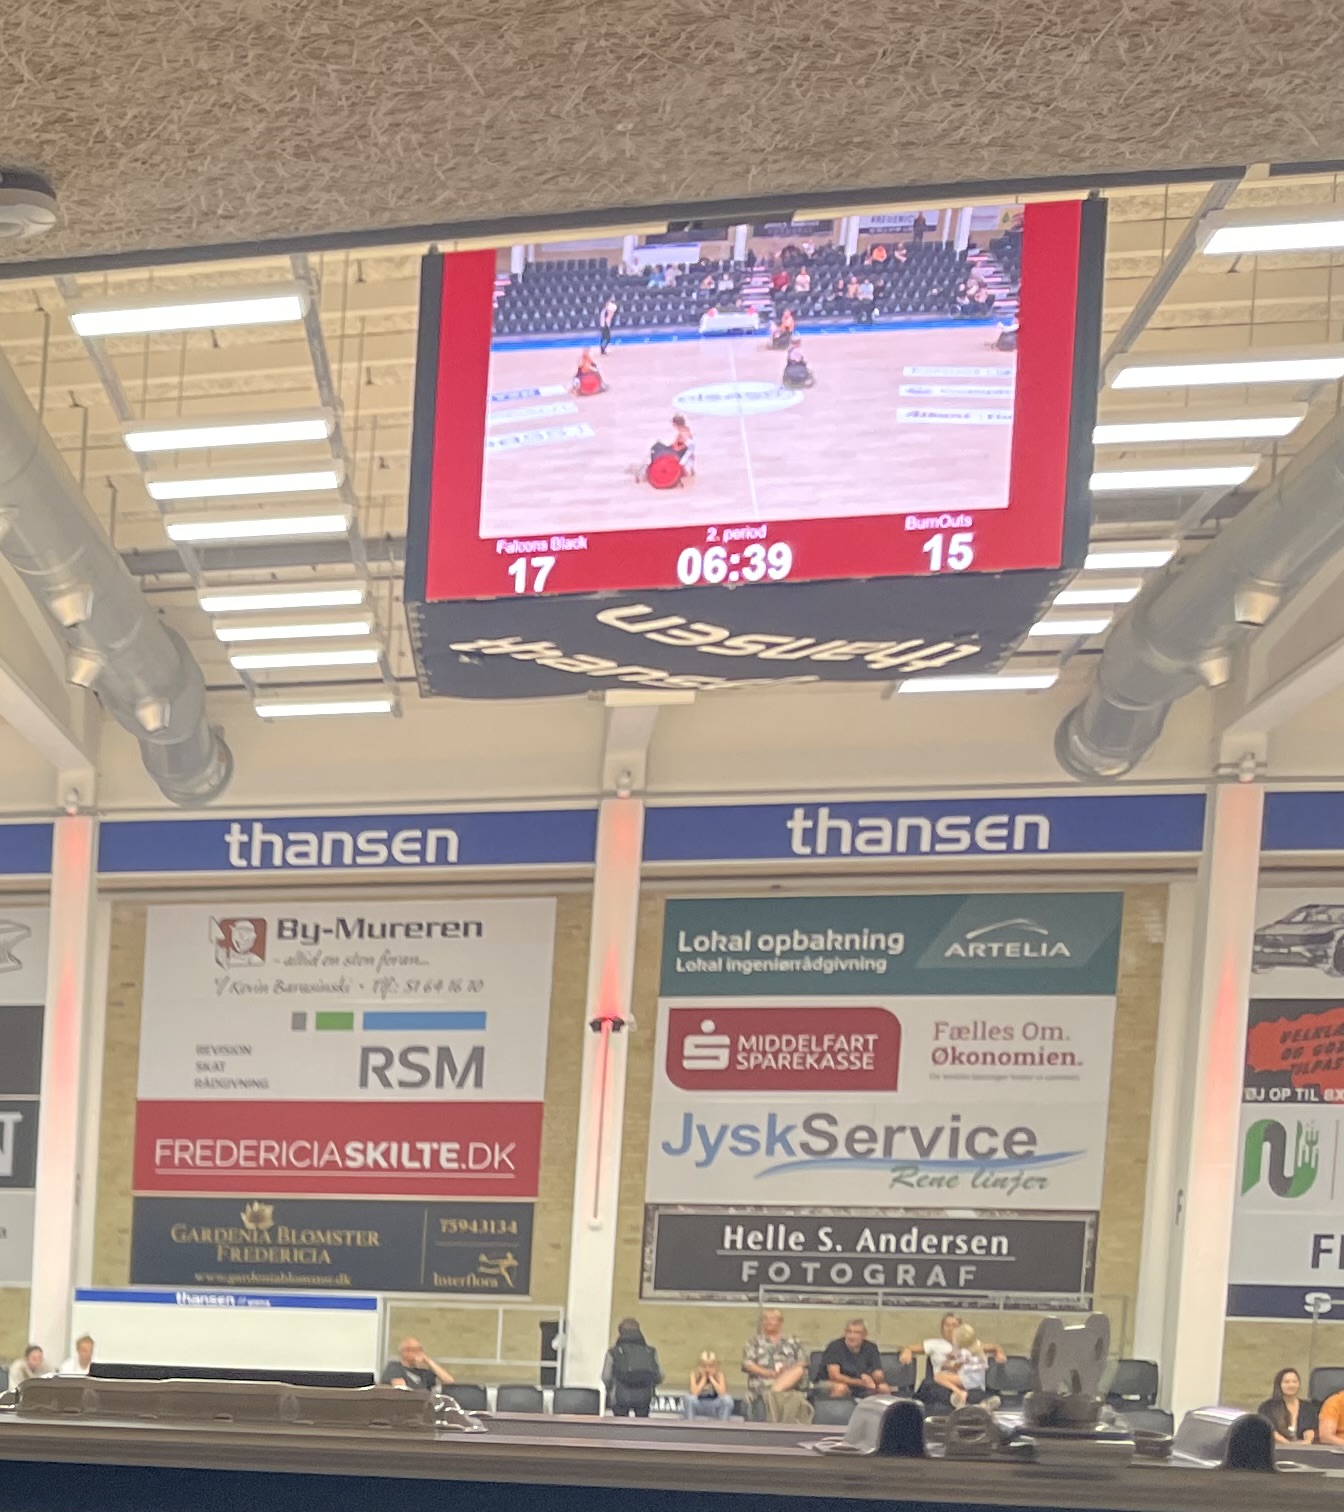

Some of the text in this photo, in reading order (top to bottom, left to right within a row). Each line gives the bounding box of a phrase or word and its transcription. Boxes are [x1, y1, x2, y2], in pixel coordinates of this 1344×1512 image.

[706, 524, 768, 542] 2. period
[905, 514, 972, 531] BurnOuts
[676, 542, 793, 585] 06:39
[923, 532, 975, 571] 15
[508, 556, 556, 593] 17
[786, 807, 1050, 855] thansen
[224, 822, 459, 868] thansen
[276, 917, 484, 945] By-Mureren
[678, 928, 905, 956] Lokal opbakning
[944, 941, 1071, 958] ARTELIA
[675, 957, 723, 972] Lokal
[934, 1020, 1070, 1042] Fælles Om.
[195, 1044, 252, 1056] REVISION
[737, 1034, 879, 1053] MIDDELFART
[195, 1061, 226, 1073] SKAT
[359, 1045, 485, 1089] RSM
[736, 1052, 875, 1071] SPAREKASSE
[931, 1044, 1083, 1068] Økonomien.
[194, 1076, 270, 1090] RÅDGIVNING
[1269, 1088, 1318, 1101] OP TIL
[661, 1111, 1038, 1168] JyskService
[155, 1138, 517, 1171] FREDERICIASKILTE.DK
[723, 1225, 1009, 1256] Helle S. Andersen
[741, 1261, 977, 1287] FOTOGRAF
[176, 1291, 235, 1307] thansen
